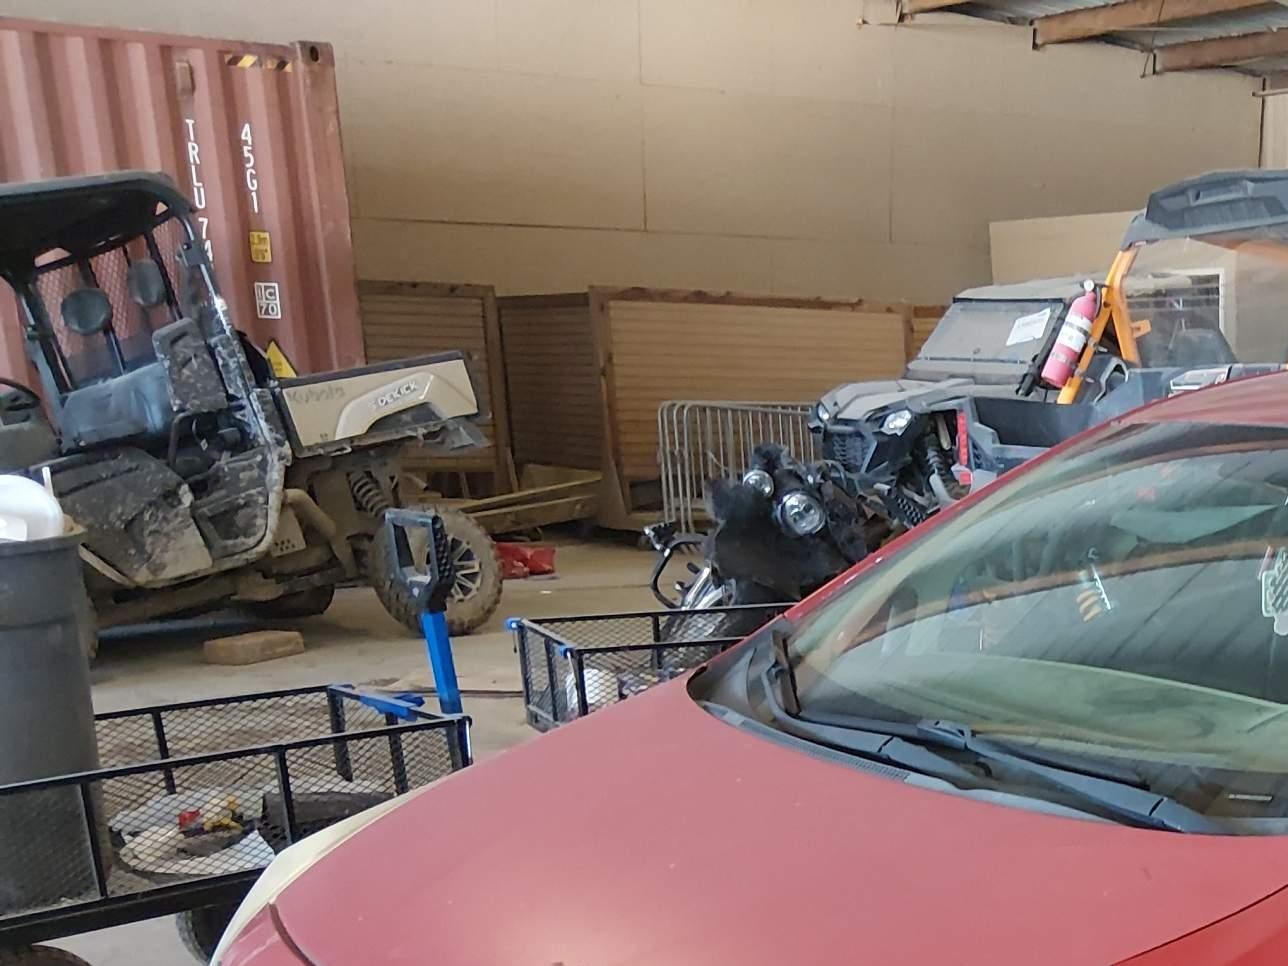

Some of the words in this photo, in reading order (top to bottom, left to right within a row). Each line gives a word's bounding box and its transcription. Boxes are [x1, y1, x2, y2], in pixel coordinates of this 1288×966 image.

[185, 118, 206, 209] TRLU
[241, 123, 258, 213] 45G1
[260, 303, 278, 316] 70
